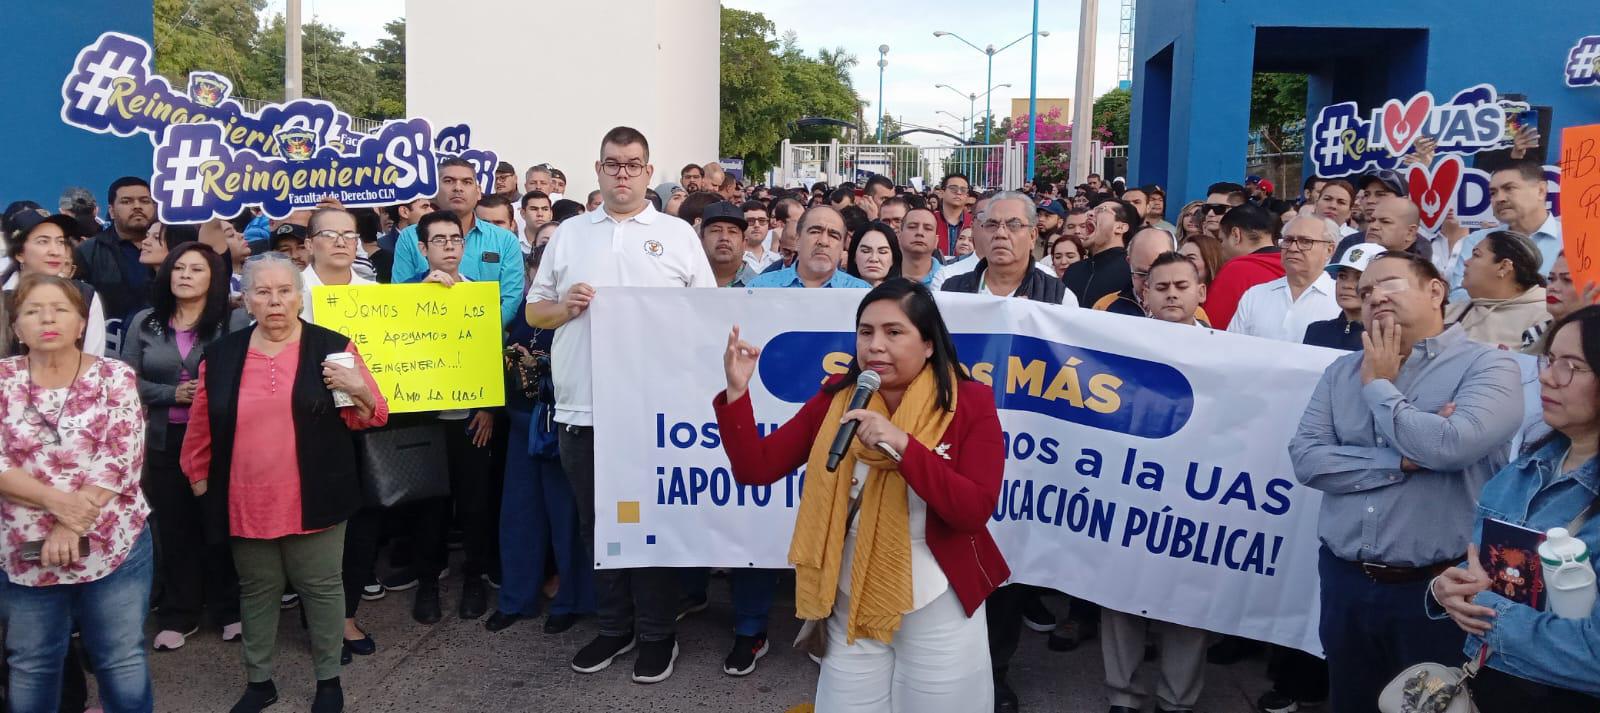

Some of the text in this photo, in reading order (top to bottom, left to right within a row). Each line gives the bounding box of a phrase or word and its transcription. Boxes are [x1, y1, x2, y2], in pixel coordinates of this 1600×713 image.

[1421, 109, 1501, 143] UAS
[163, 138, 399, 208] #Reingeniería
[385, 132, 429, 189] Sí
[341, 189, 378, 201] Derecho
[458, 329, 473, 341] LA
[1005, 355, 1124, 415] MÁS
[656, 413, 721, 449] los
[1074, 448, 1104, 479] a
[1121, 447, 1166, 492] la
[1185, 461, 1295, 516] UAS
[1121, 504, 1284, 577] PÚBLICA!
